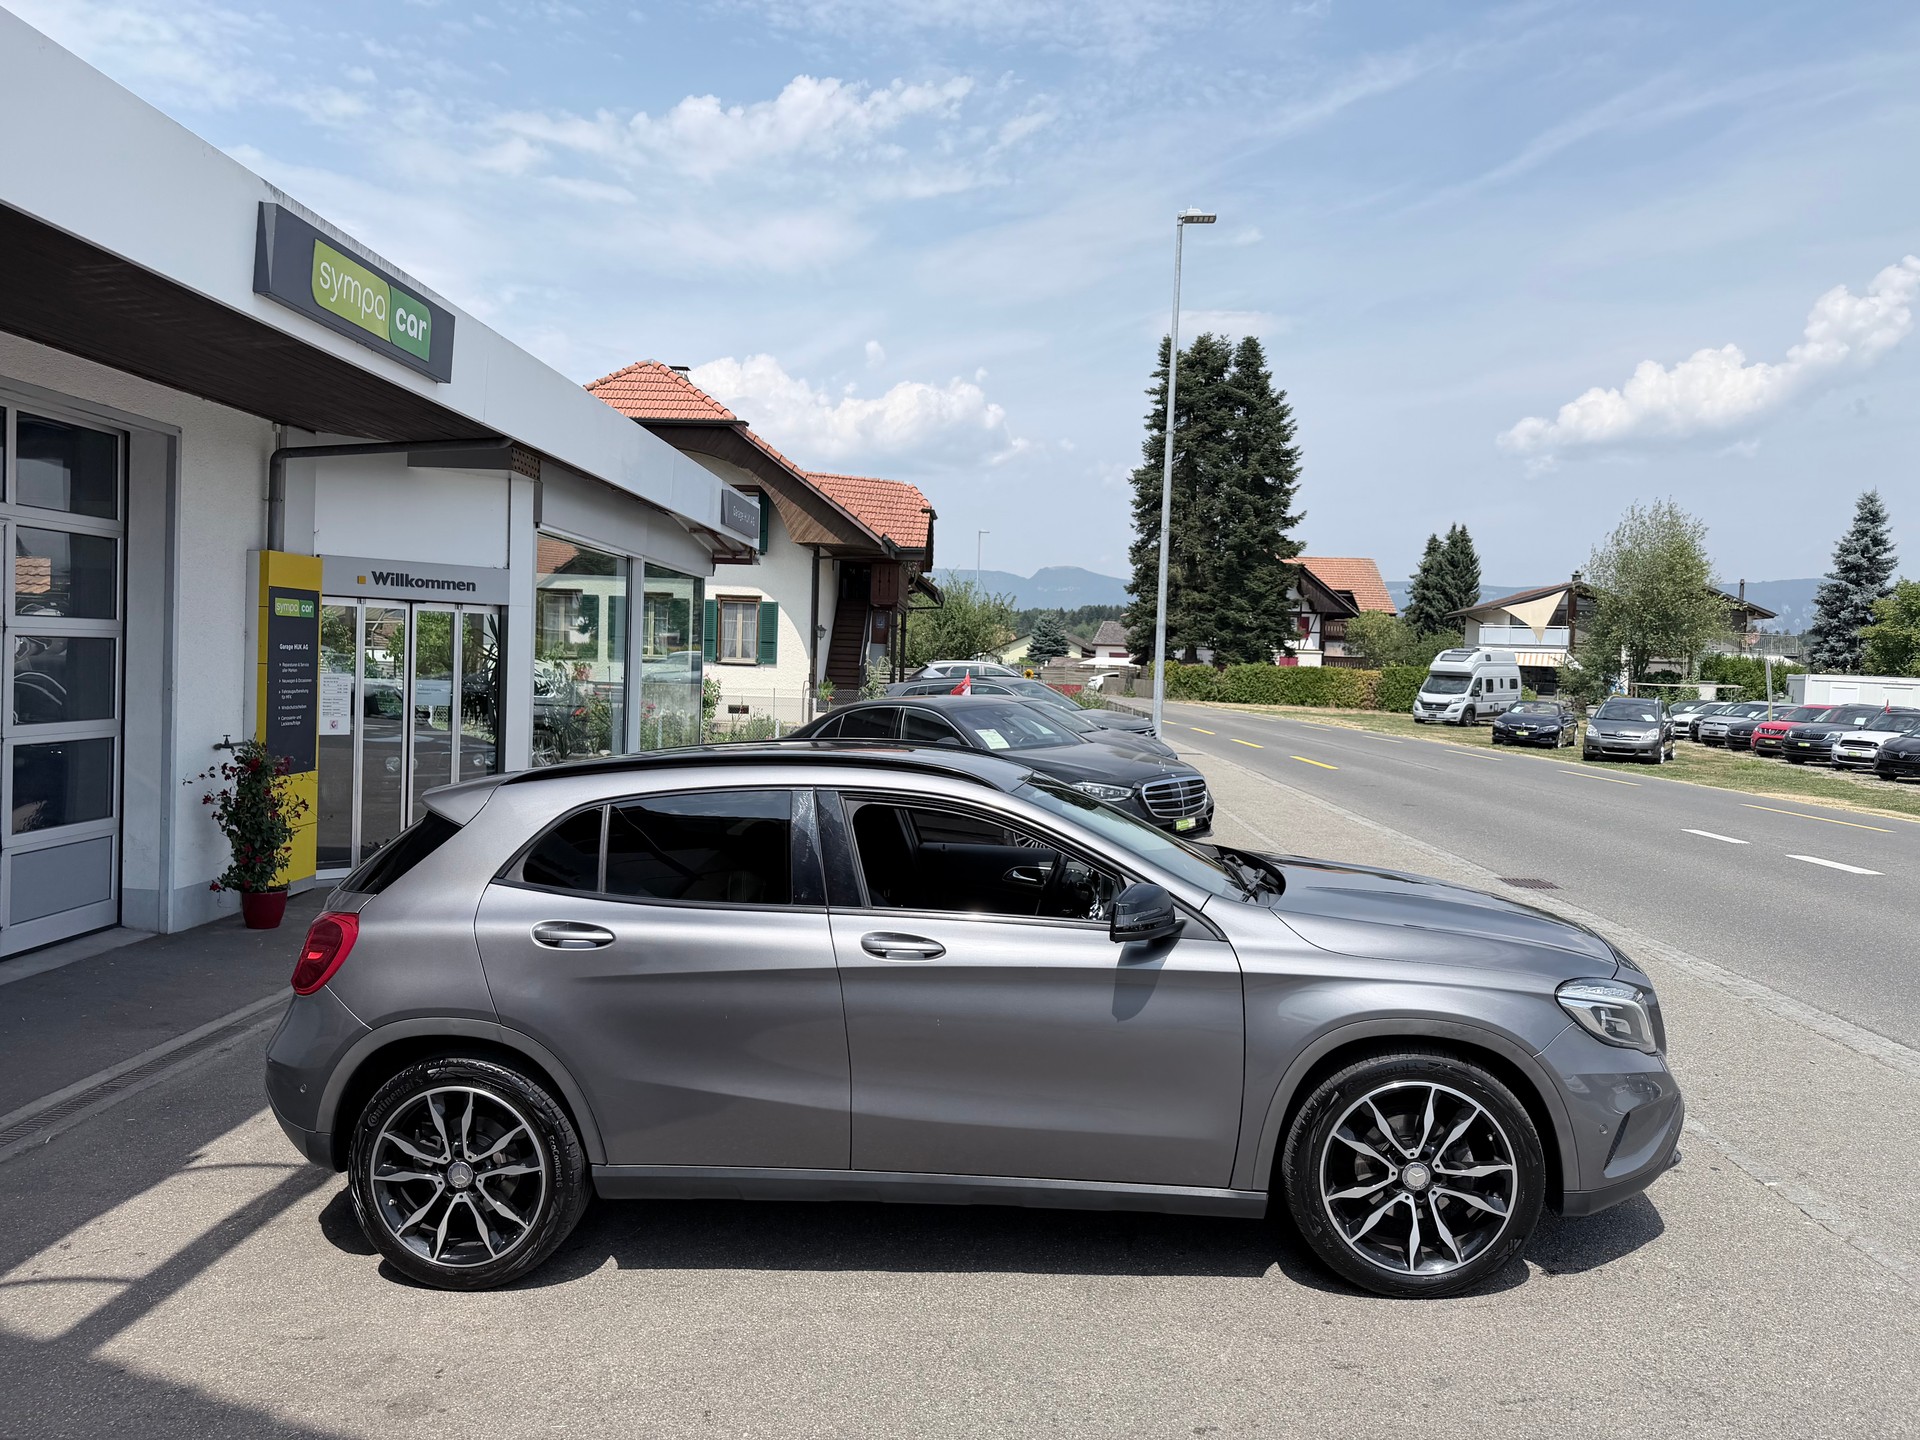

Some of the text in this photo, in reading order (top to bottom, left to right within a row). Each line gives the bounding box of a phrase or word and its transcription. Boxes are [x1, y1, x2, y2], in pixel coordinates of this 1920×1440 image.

[319, 261, 428, 342] sympa car
[371, 571, 477, 592] Willkommen
[276, 602, 313, 614] sympa car
[279, 643, 293, 651] Garage
[367, 1079, 415, 1127] Continental
[547, 1134, 563, 1181] EcoContact
